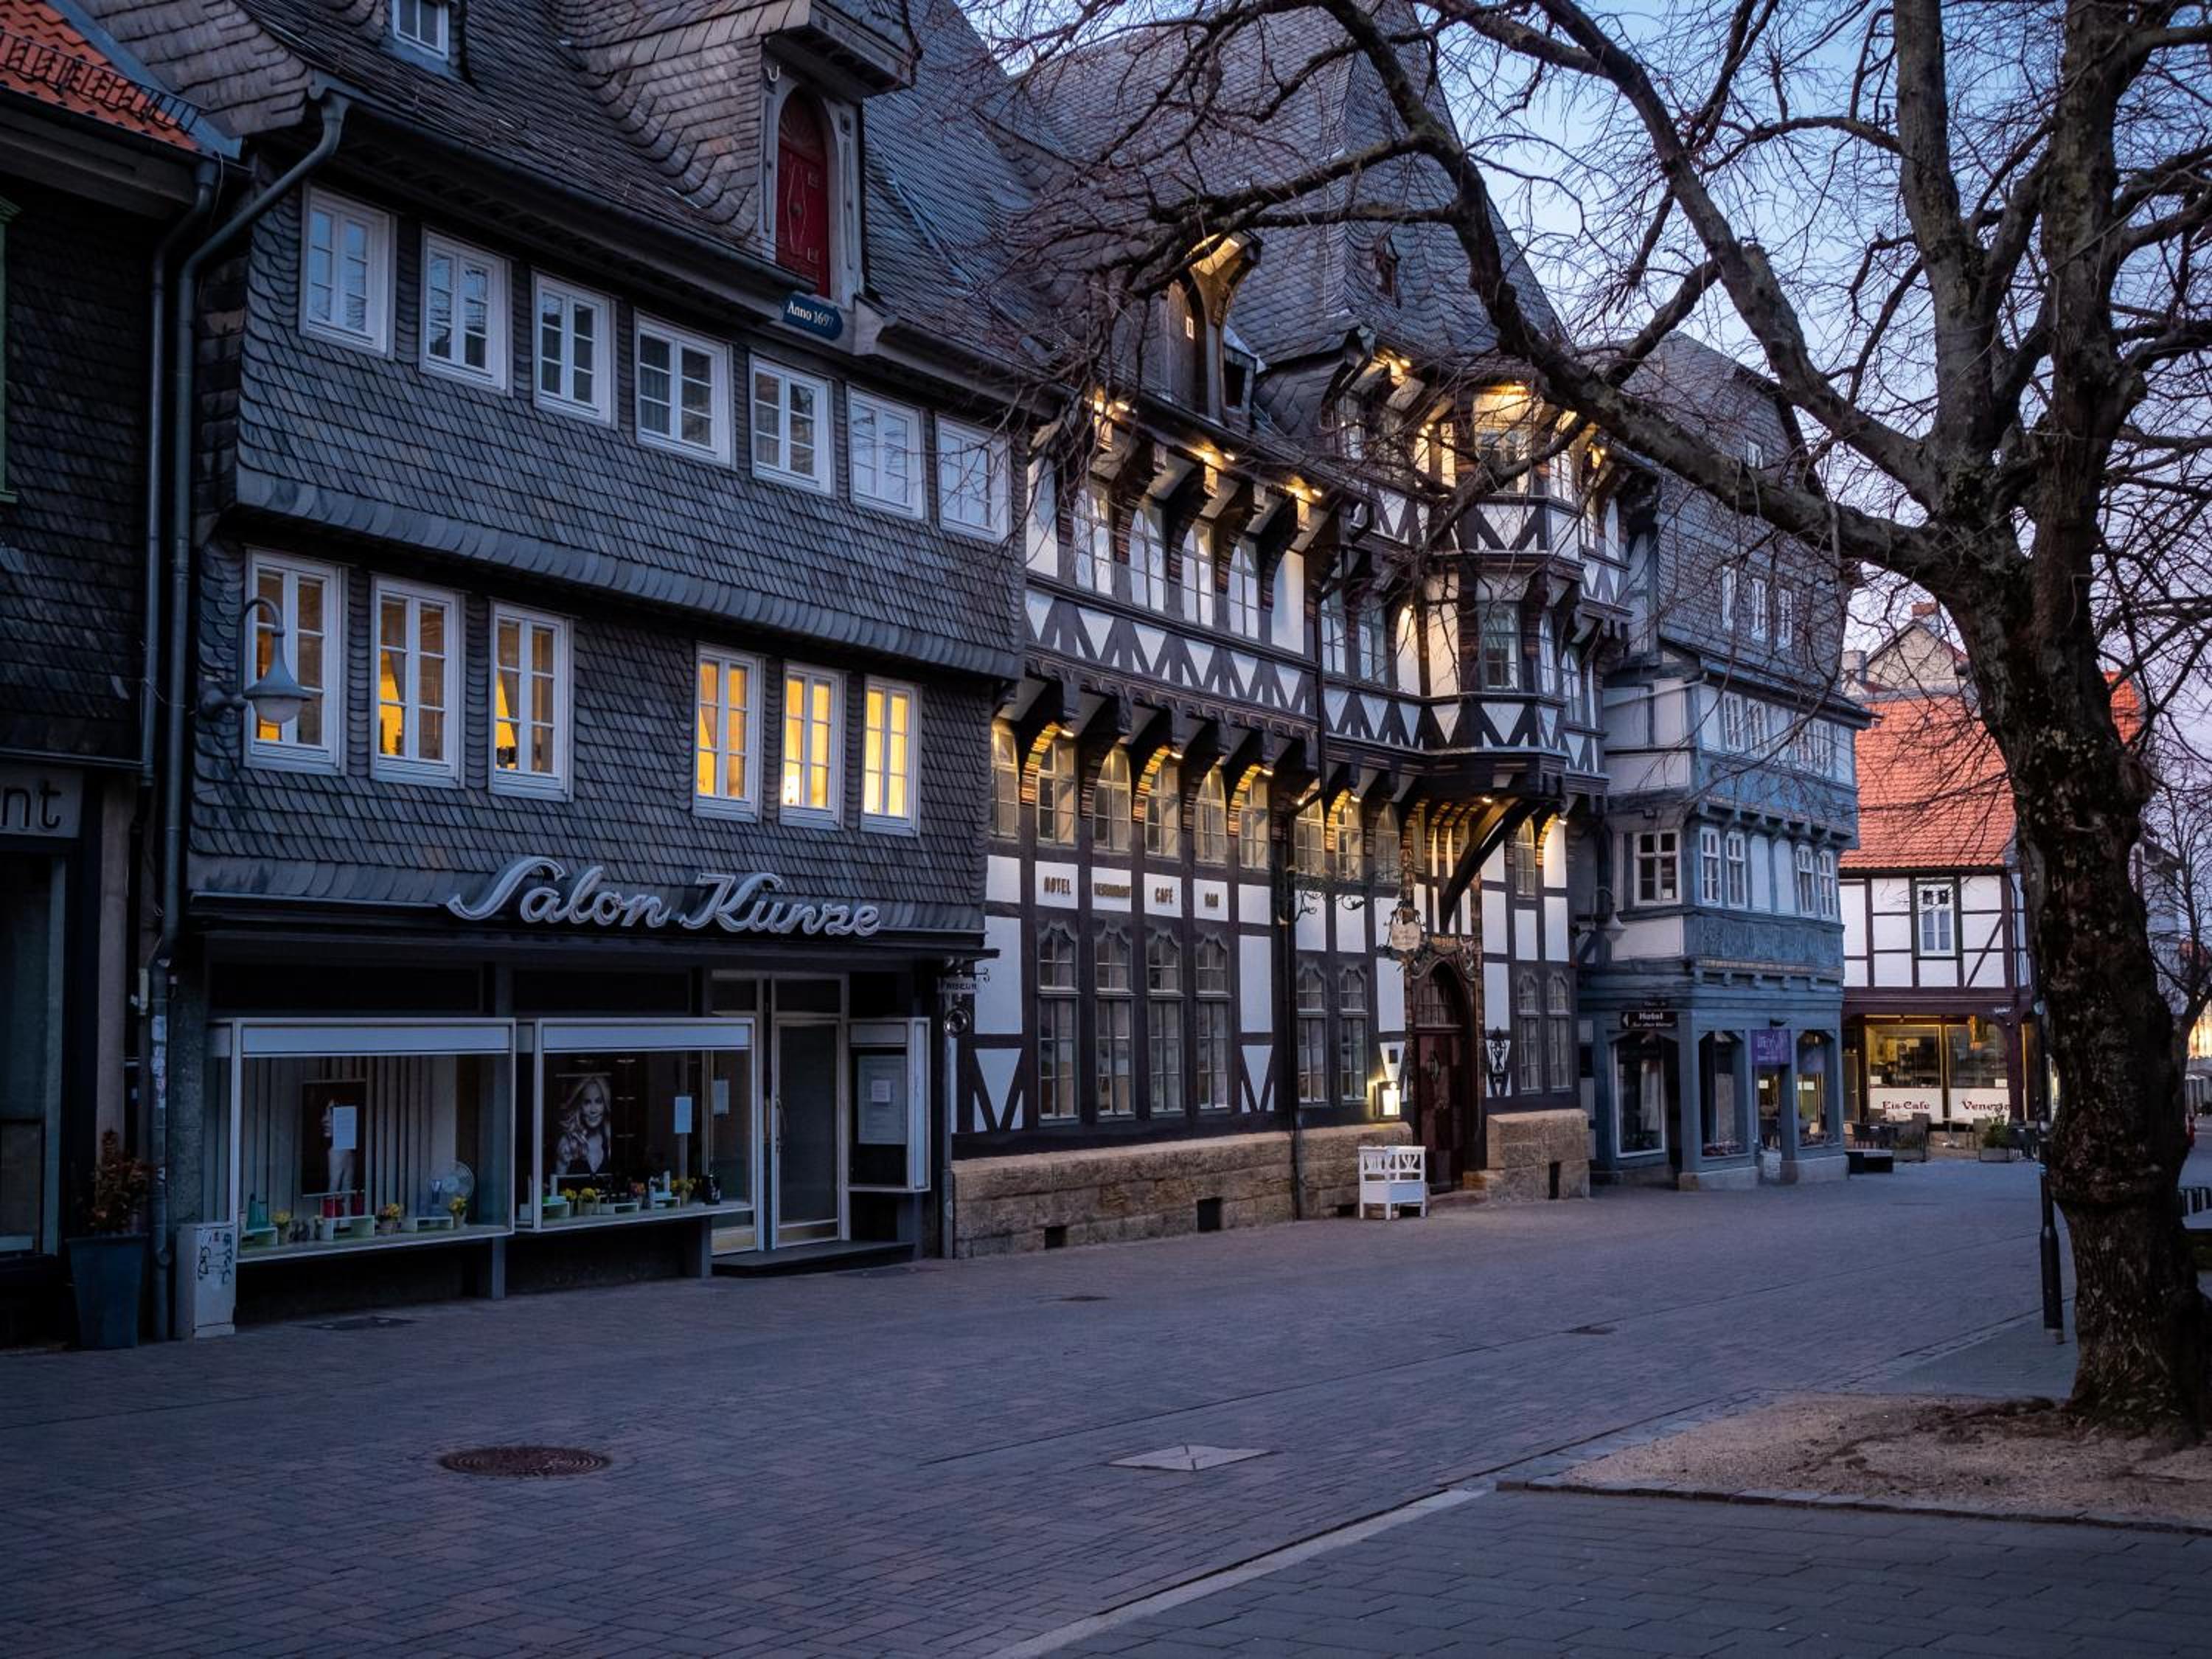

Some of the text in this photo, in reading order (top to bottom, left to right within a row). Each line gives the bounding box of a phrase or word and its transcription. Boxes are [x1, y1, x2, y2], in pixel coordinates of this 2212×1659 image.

[787, 300, 812, 321] Anno
[446, 855, 882, 936] Salon Kunze
[1044, 876, 1071, 895] HOTEL
